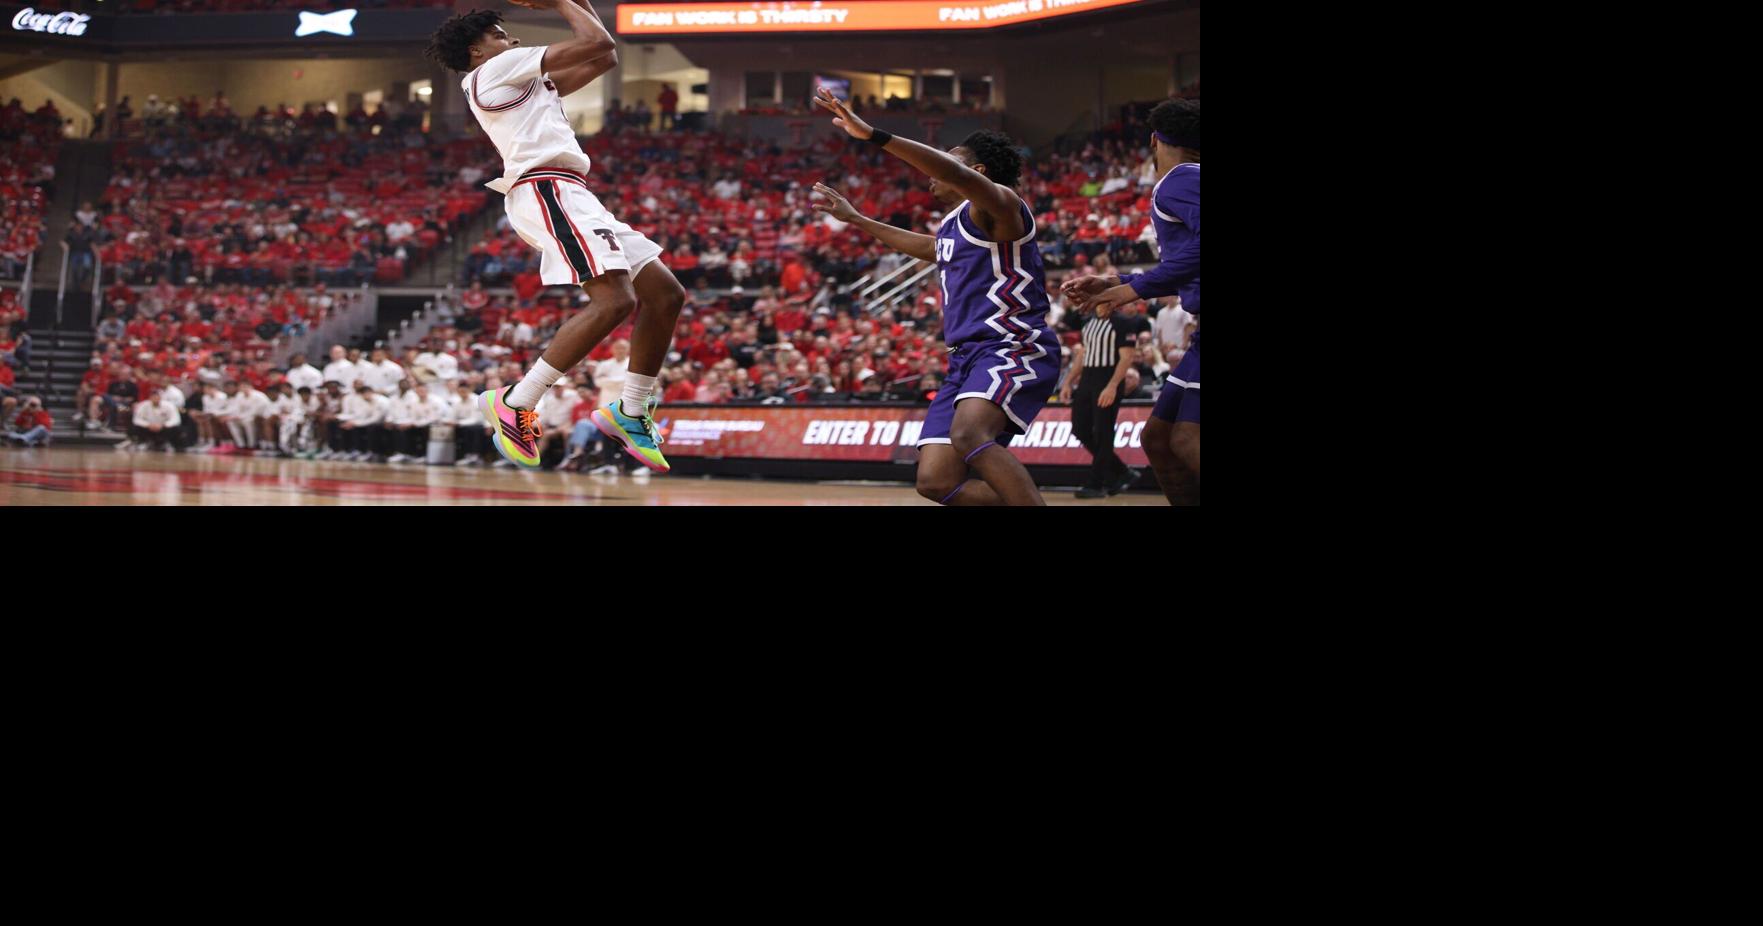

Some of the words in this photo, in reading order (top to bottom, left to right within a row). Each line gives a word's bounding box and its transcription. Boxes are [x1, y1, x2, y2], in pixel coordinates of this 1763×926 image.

[632, 12, 674, 26] FAN
[676, 12, 737, 25] WORK
[737, 11, 758, 24] IS
[760, 9, 849, 24] THIRSTY
[939, 8, 980, 21] FAN
[983, 4, 1027, 19] WORK
[934, 237, 955, 263] CU
[802, 420, 870, 445] ENTER
[870, 420, 900, 446] TO
